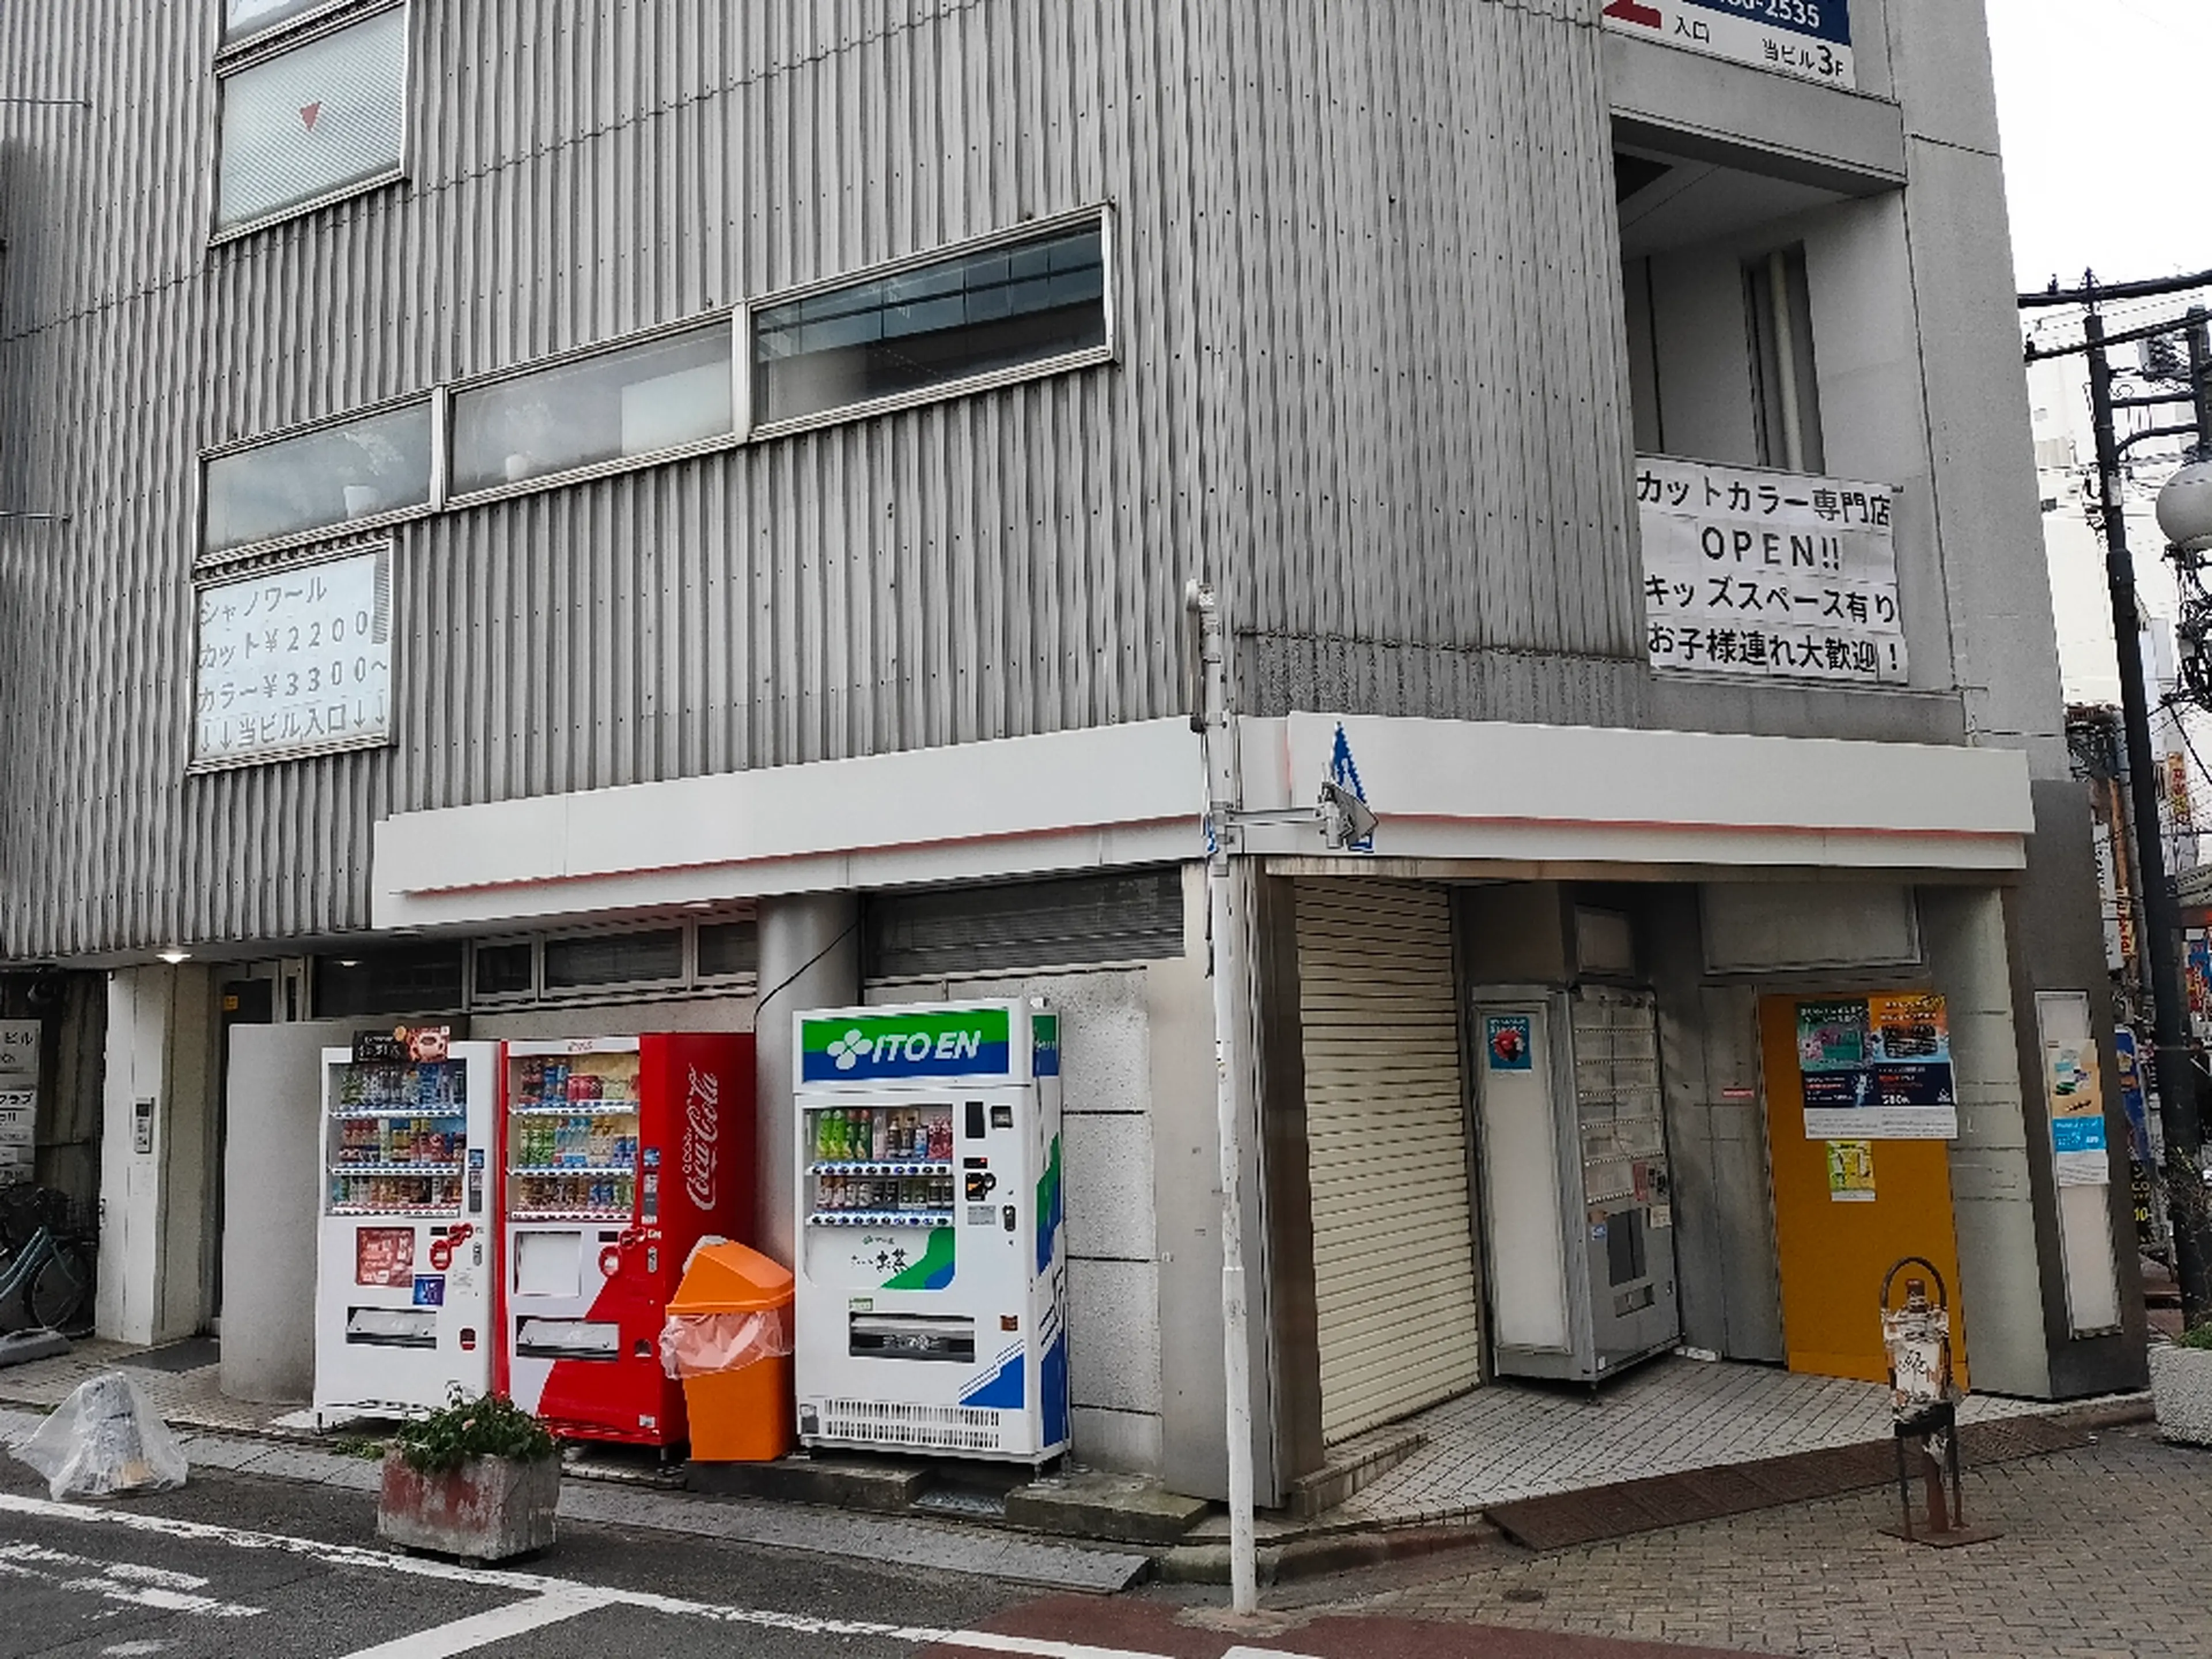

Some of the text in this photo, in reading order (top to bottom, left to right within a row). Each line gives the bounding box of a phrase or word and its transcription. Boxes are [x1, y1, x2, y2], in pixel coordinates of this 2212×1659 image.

[1675, 14, 1710, 44] 入口
[1637, 470, 1890, 527] カットカラー専門店
[1701, 526, 1839, 571] OPEN!!
[200, 577, 327, 626] シャノワール
[1645, 574, 1896, 624] キッズスペース有り
[238, 704, 346, 748] 当ビル入口
[872, 1030, 982, 1063] ITO EN
[682, 1062, 718, 1211] Coca-Cola
